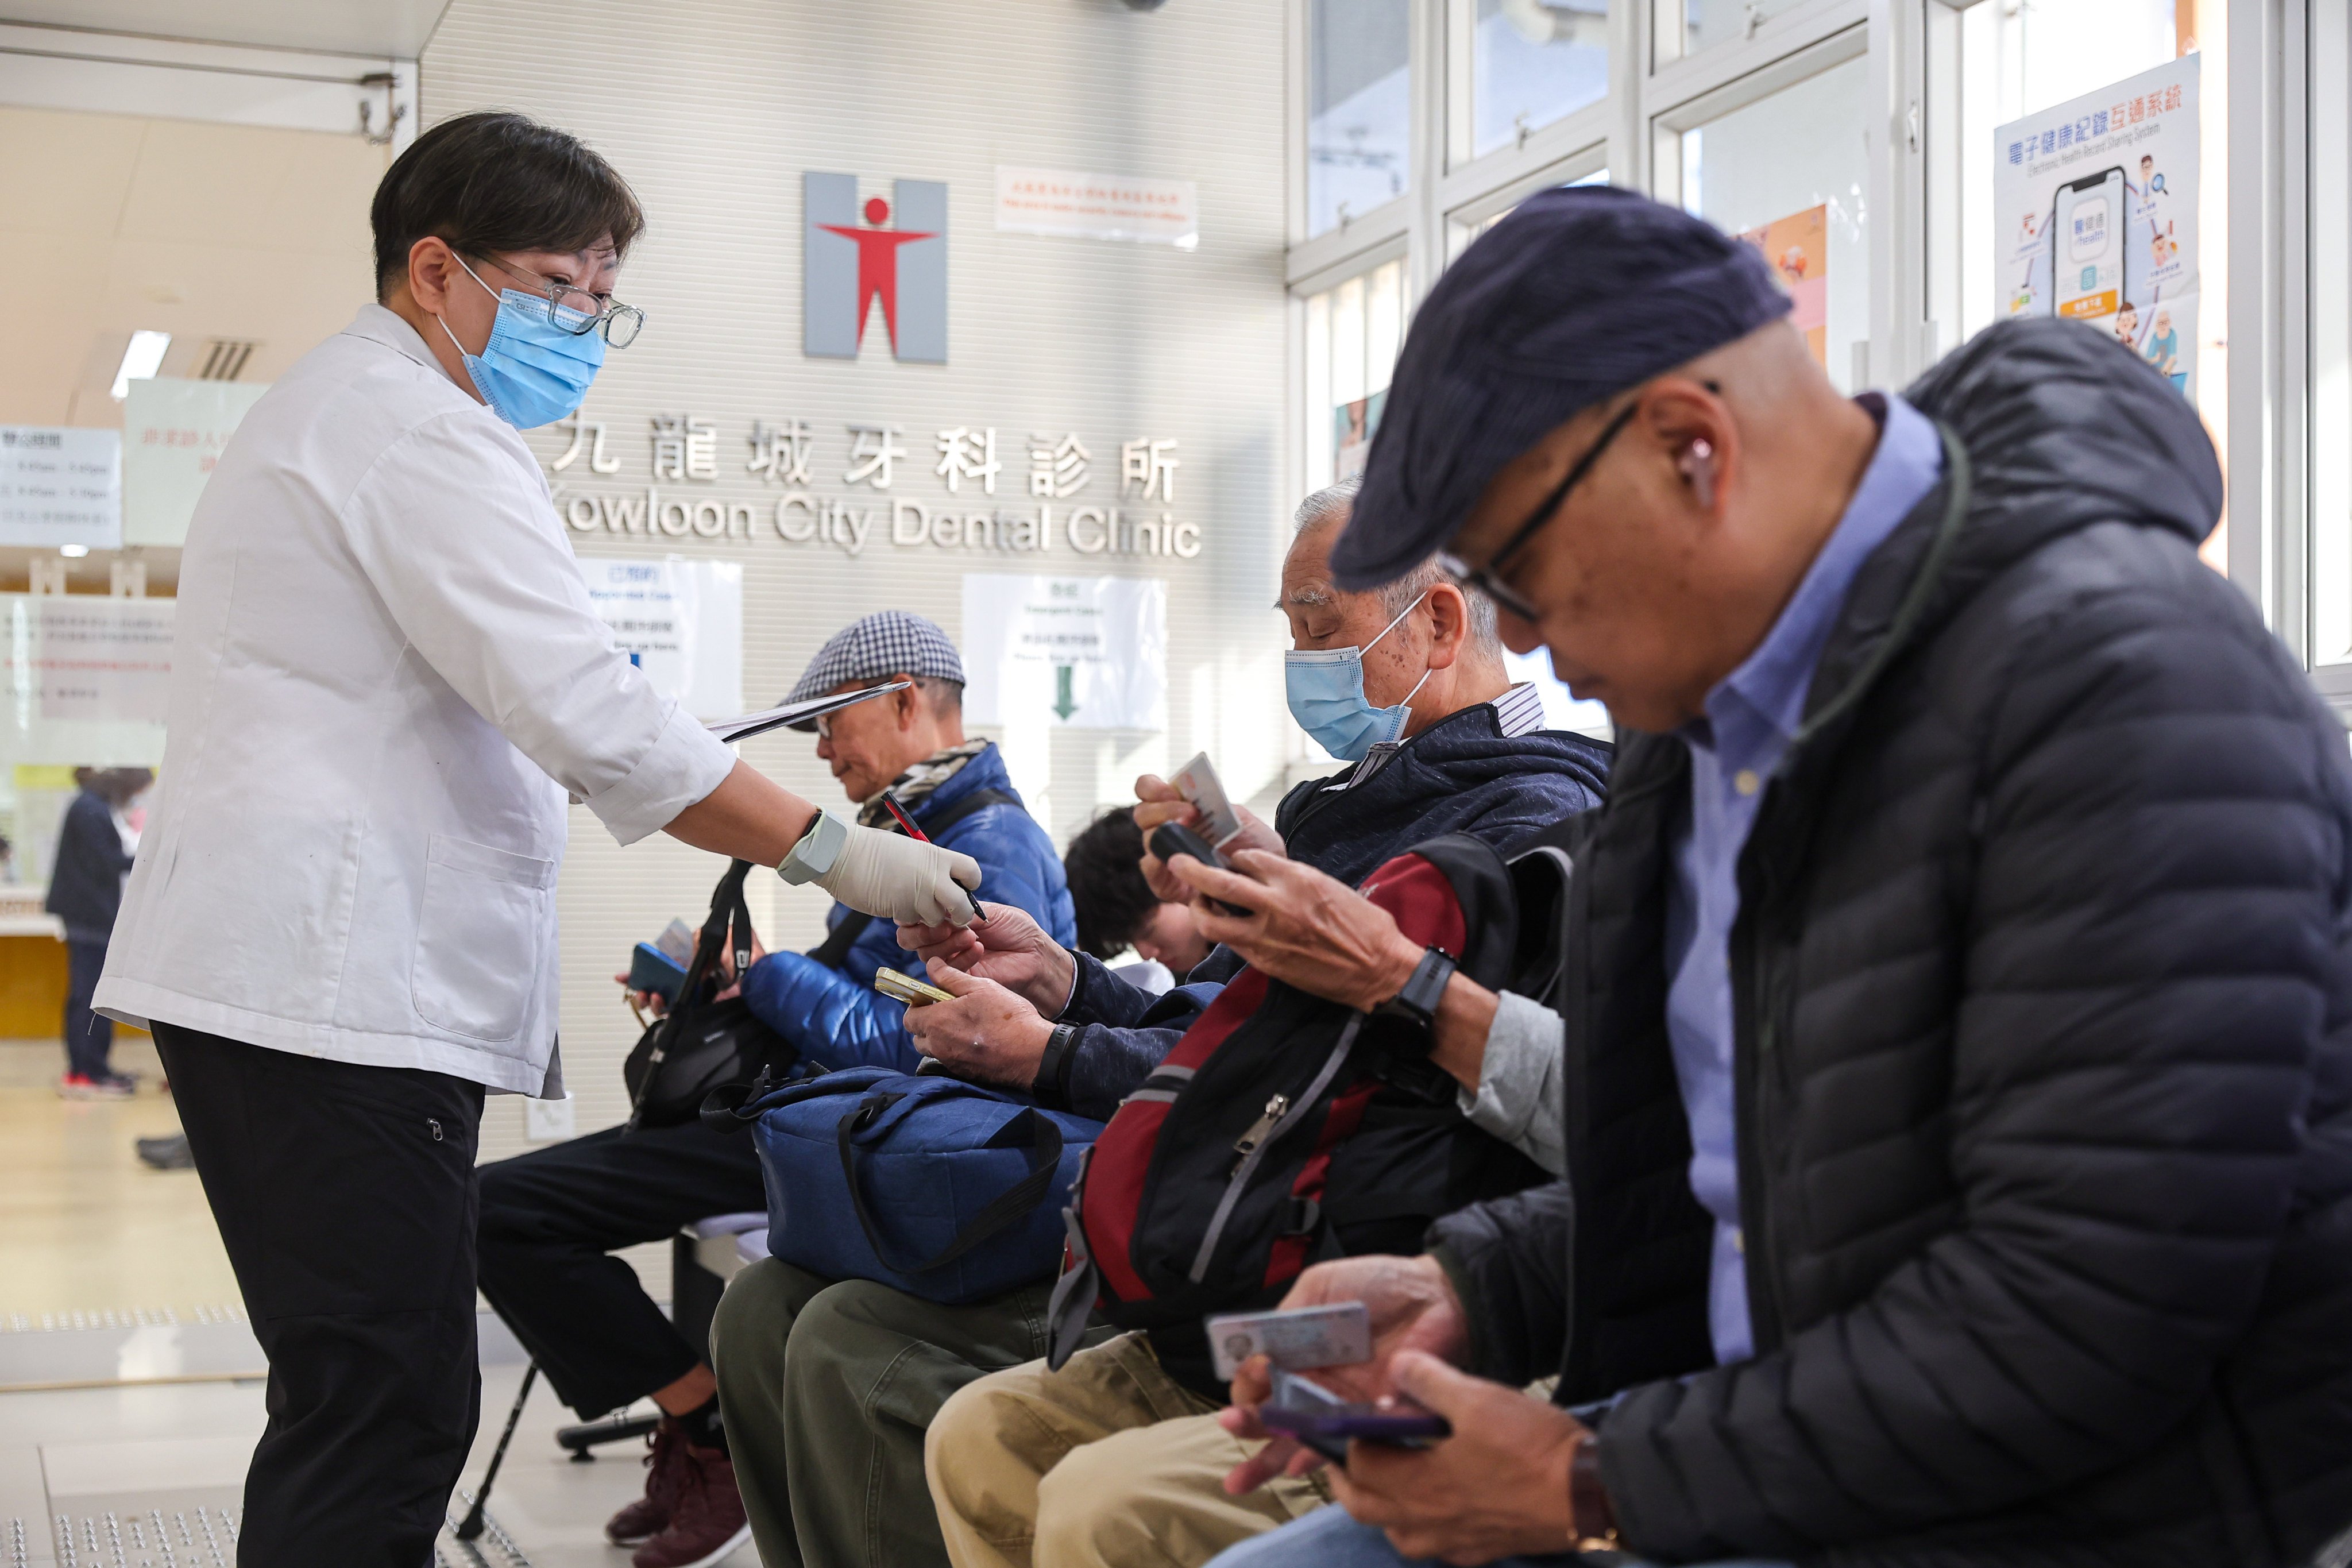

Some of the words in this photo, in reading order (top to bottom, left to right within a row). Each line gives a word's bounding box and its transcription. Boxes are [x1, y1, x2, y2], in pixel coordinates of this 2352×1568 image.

[2009, 83, 2183, 166] 電子健康紀錄互通系統
[2061, 148, 2083, 165] Health
[2134, 122, 2161, 143] System
[551, 405, 1180, 503] 九龍城牙科診所
[775, 492, 874, 555] City
[892, 499, 1052, 553] Dental
[1067, 505, 1203, 558] Clinic
